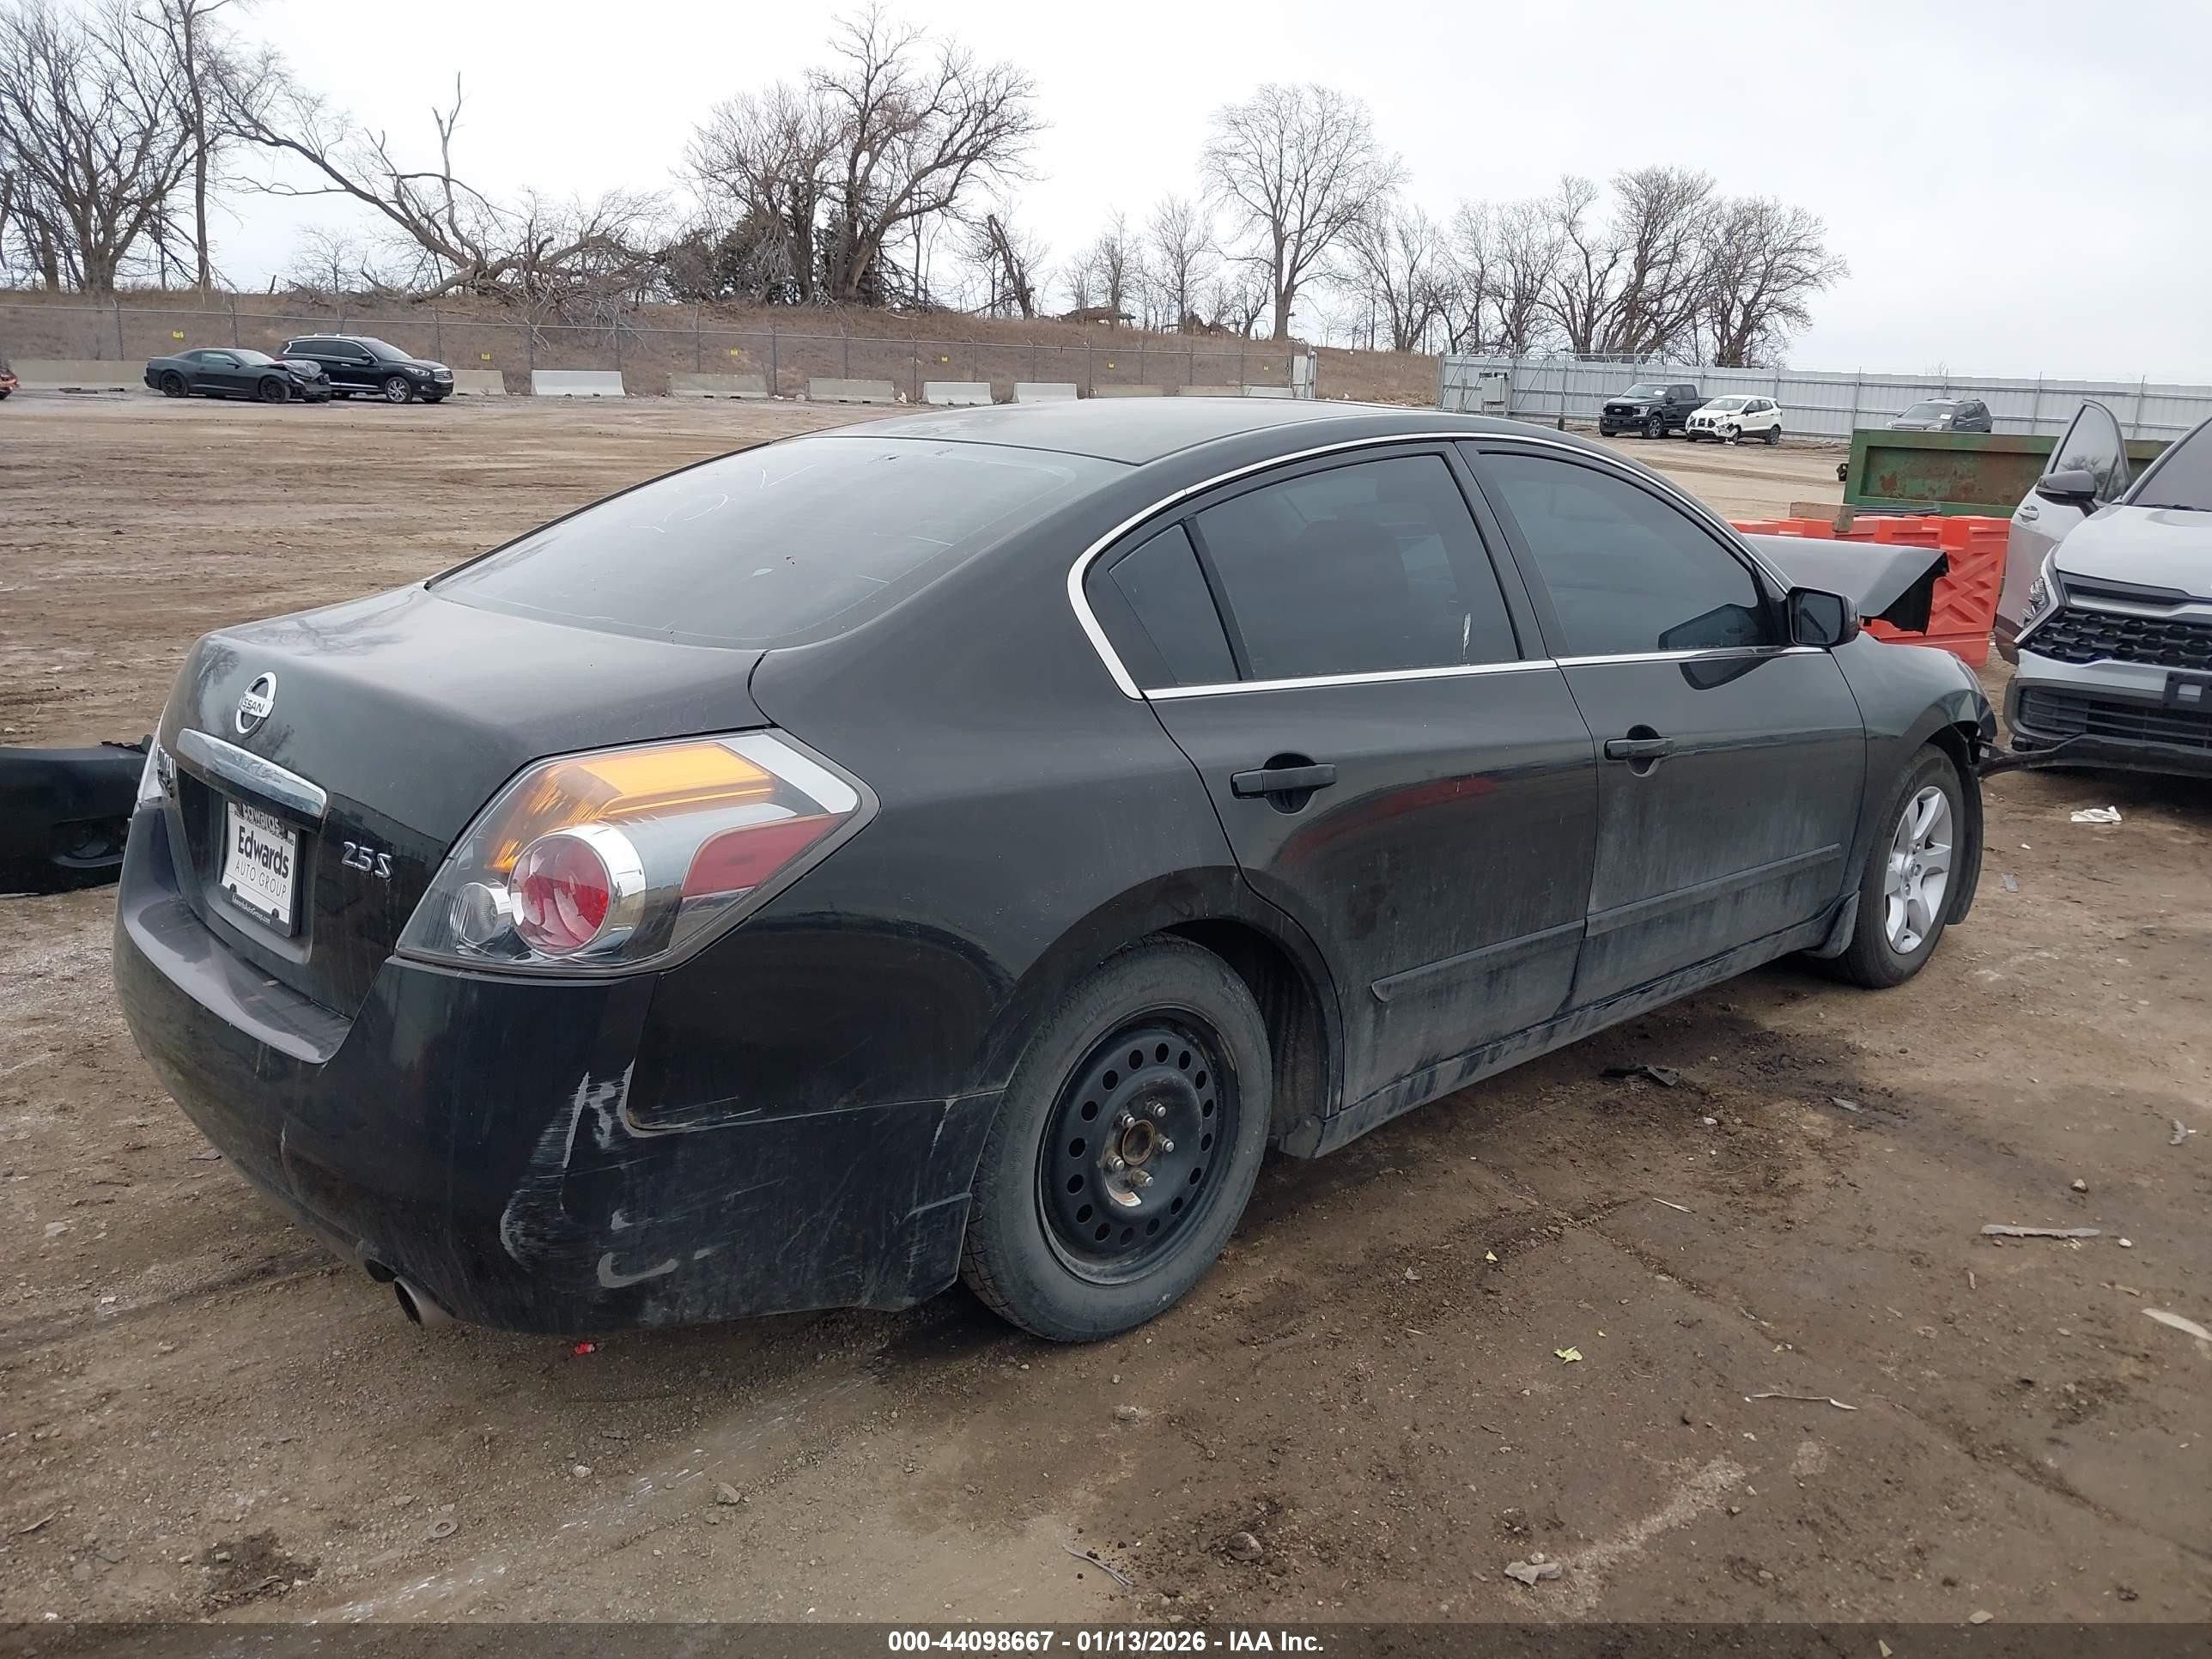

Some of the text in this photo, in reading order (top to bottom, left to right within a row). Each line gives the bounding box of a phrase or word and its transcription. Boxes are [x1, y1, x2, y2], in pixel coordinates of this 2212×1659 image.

[241, 697, 265, 714] SSAN
[237, 824, 289, 879] Edwards
[234, 860, 287, 899] AUTO GROUP
